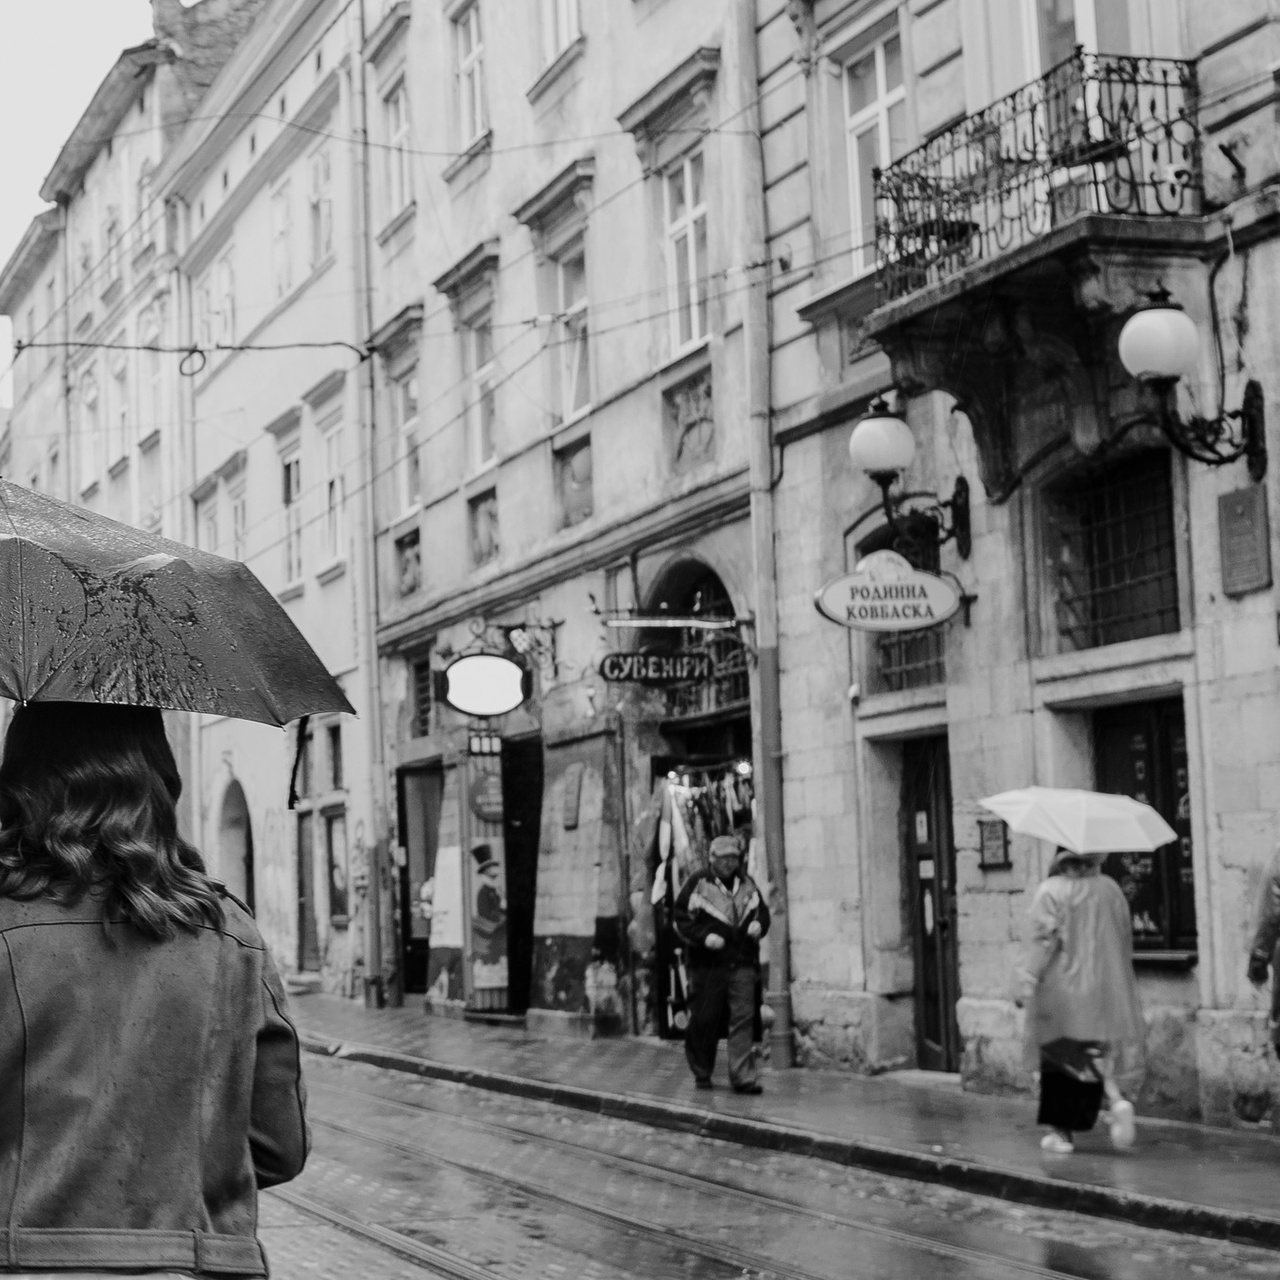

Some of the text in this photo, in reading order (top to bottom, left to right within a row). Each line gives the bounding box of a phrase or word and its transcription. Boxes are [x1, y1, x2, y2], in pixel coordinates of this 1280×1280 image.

[850, 584, 928, 600] РОДИННА
[846, 604, 935, 620] КОВБАСКА
[603, 655, 709, 679] СУВЕНІРИ
